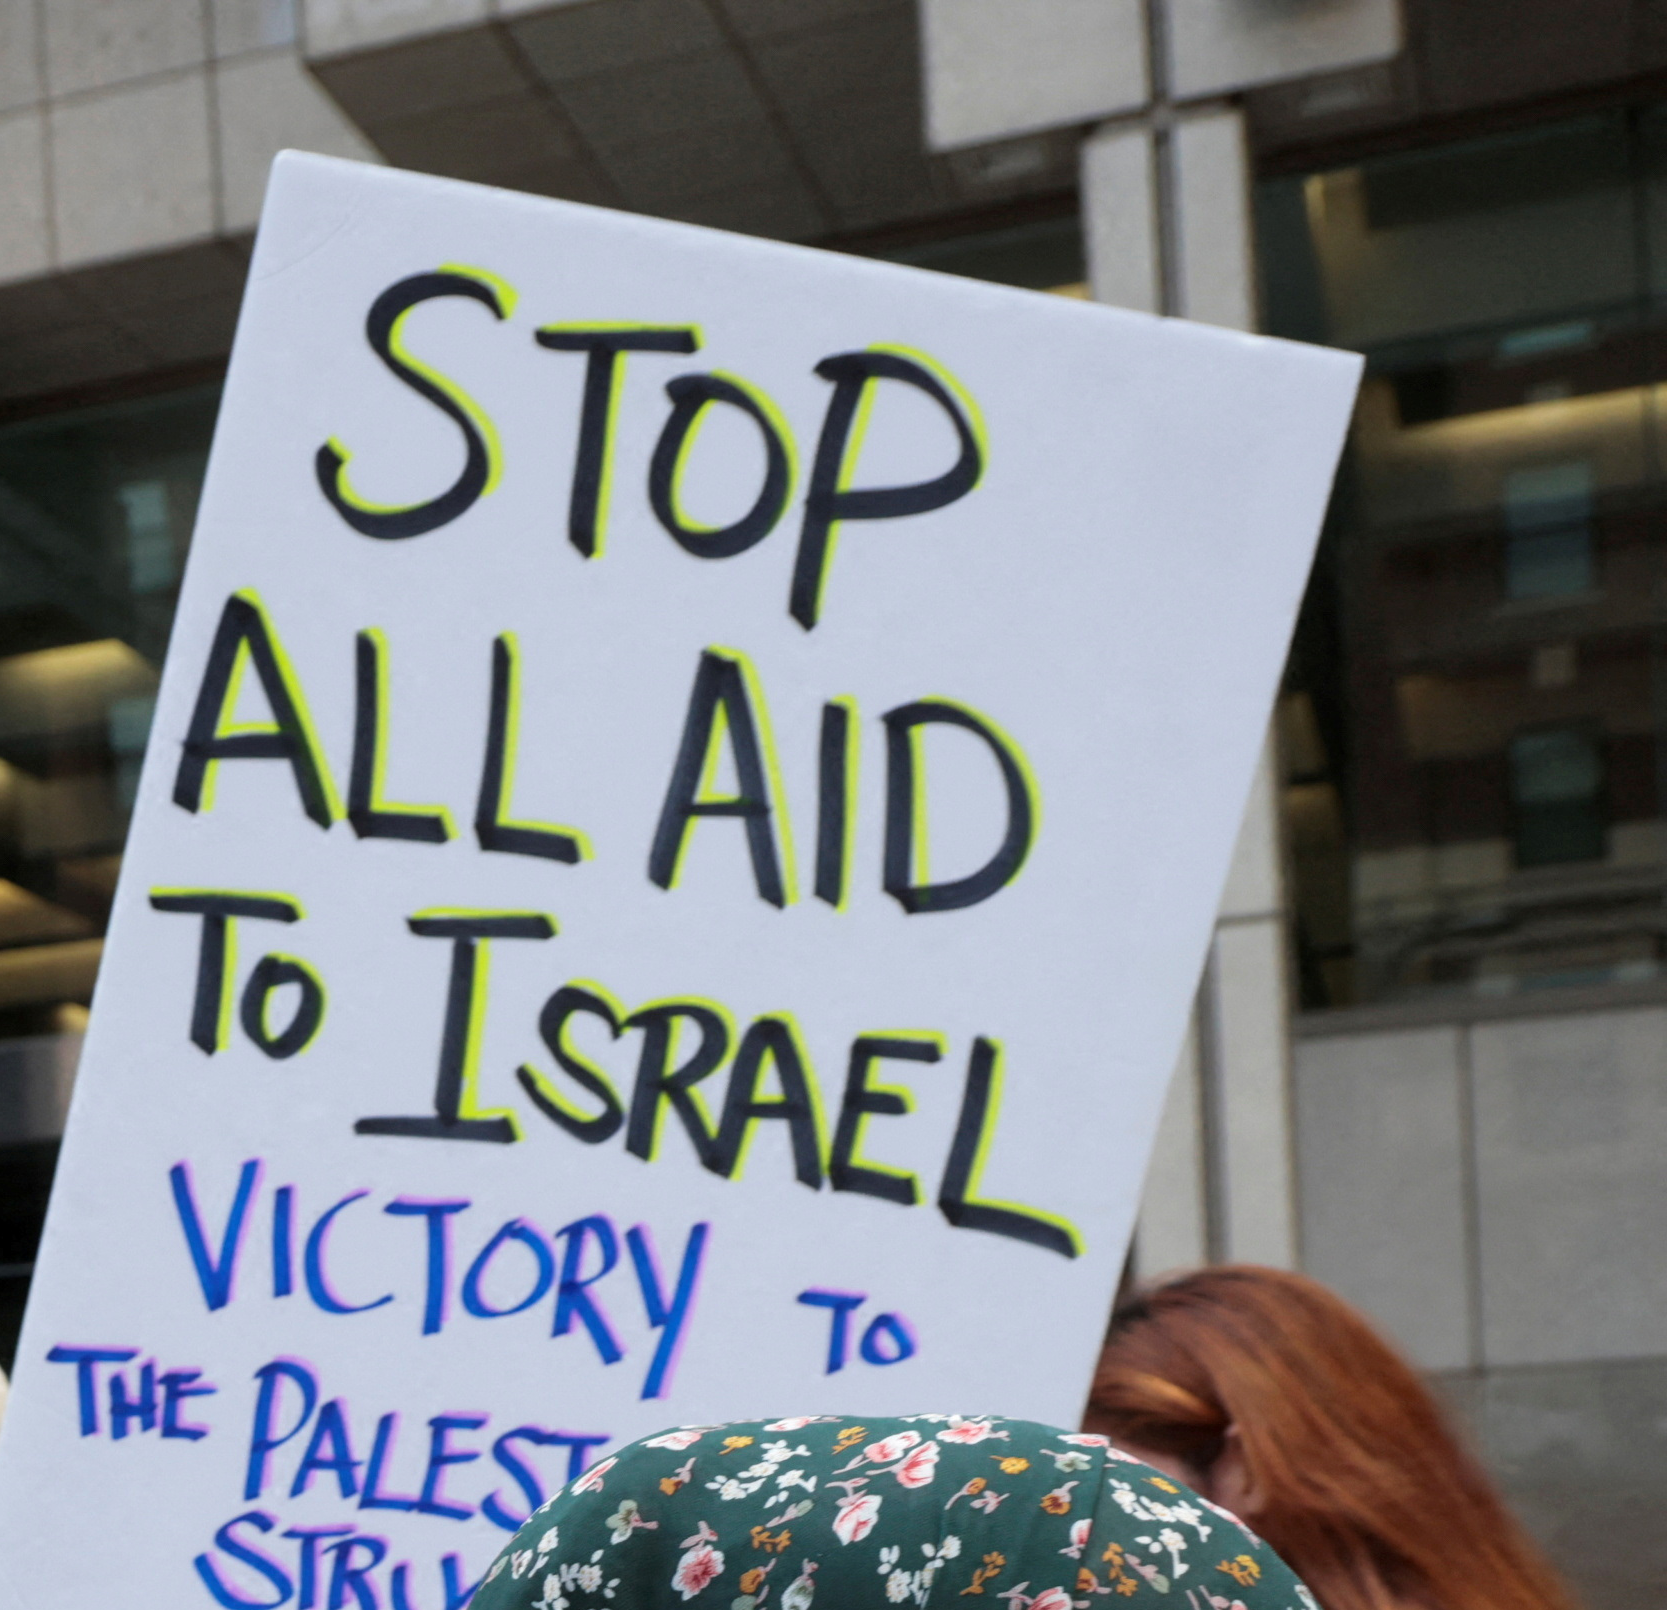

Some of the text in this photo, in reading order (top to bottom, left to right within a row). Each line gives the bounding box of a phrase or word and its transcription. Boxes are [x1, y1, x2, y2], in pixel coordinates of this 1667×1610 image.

[315, 262, 989, 632] STOP
[172, 587, 1042, 915] ALL AID
[354, 906, 1087, 1259] ISRAEL
[45, 1343, 219, 1443] THE
[168, 1157, 918, 1402] VICTORY TO
